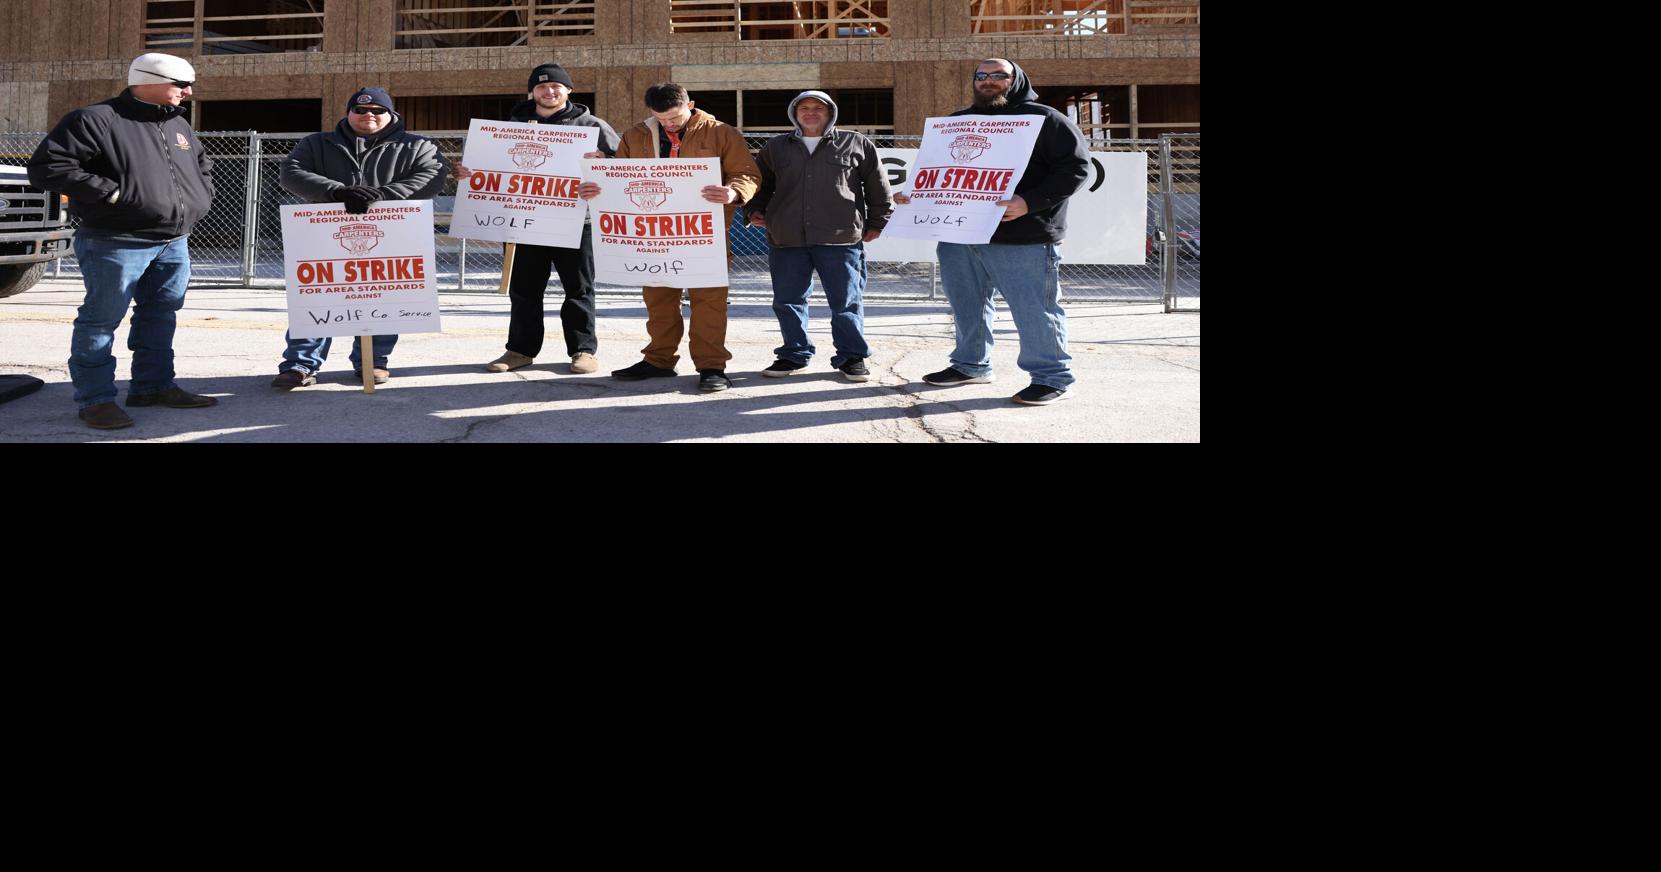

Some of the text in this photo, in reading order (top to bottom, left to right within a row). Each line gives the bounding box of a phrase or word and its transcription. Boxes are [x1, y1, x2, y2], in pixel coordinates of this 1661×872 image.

[932, 121, 977, 129] MID-AMERICA
[941, 127, 976, 135] REGIONAL
[480, 126, 588, 139] MID-AMERICA CARPENTERS
[492, 133, 574, 144] REGIONAL COUNCIL
[469, 171, 581, 199] ON STRIKE
[914, 168, 1013, 192] ON STRIKE
[467, 193, 576, 208] FOR AREA STANDARDS
[945, 192, 1003, 201] STANDARDS
[293, 206, 421, 218] MID-AMERI ARPENTERS
[309, 214, 405, 224] REGIONAL COUNCIL
[474, 214, 535, 229] WOLF
[600, 213, 714, 237] ON STRIKE
[601, 237, 618, 245] FOR
[647, 238, 713, 246] STANDARDS
[297, 258, 425, 284] ON STRIKE
[325, 286, 355, 294] AREA
[358, 283, 425, 292] STANDARDS
[308, 309, 363, 325] Wolf
